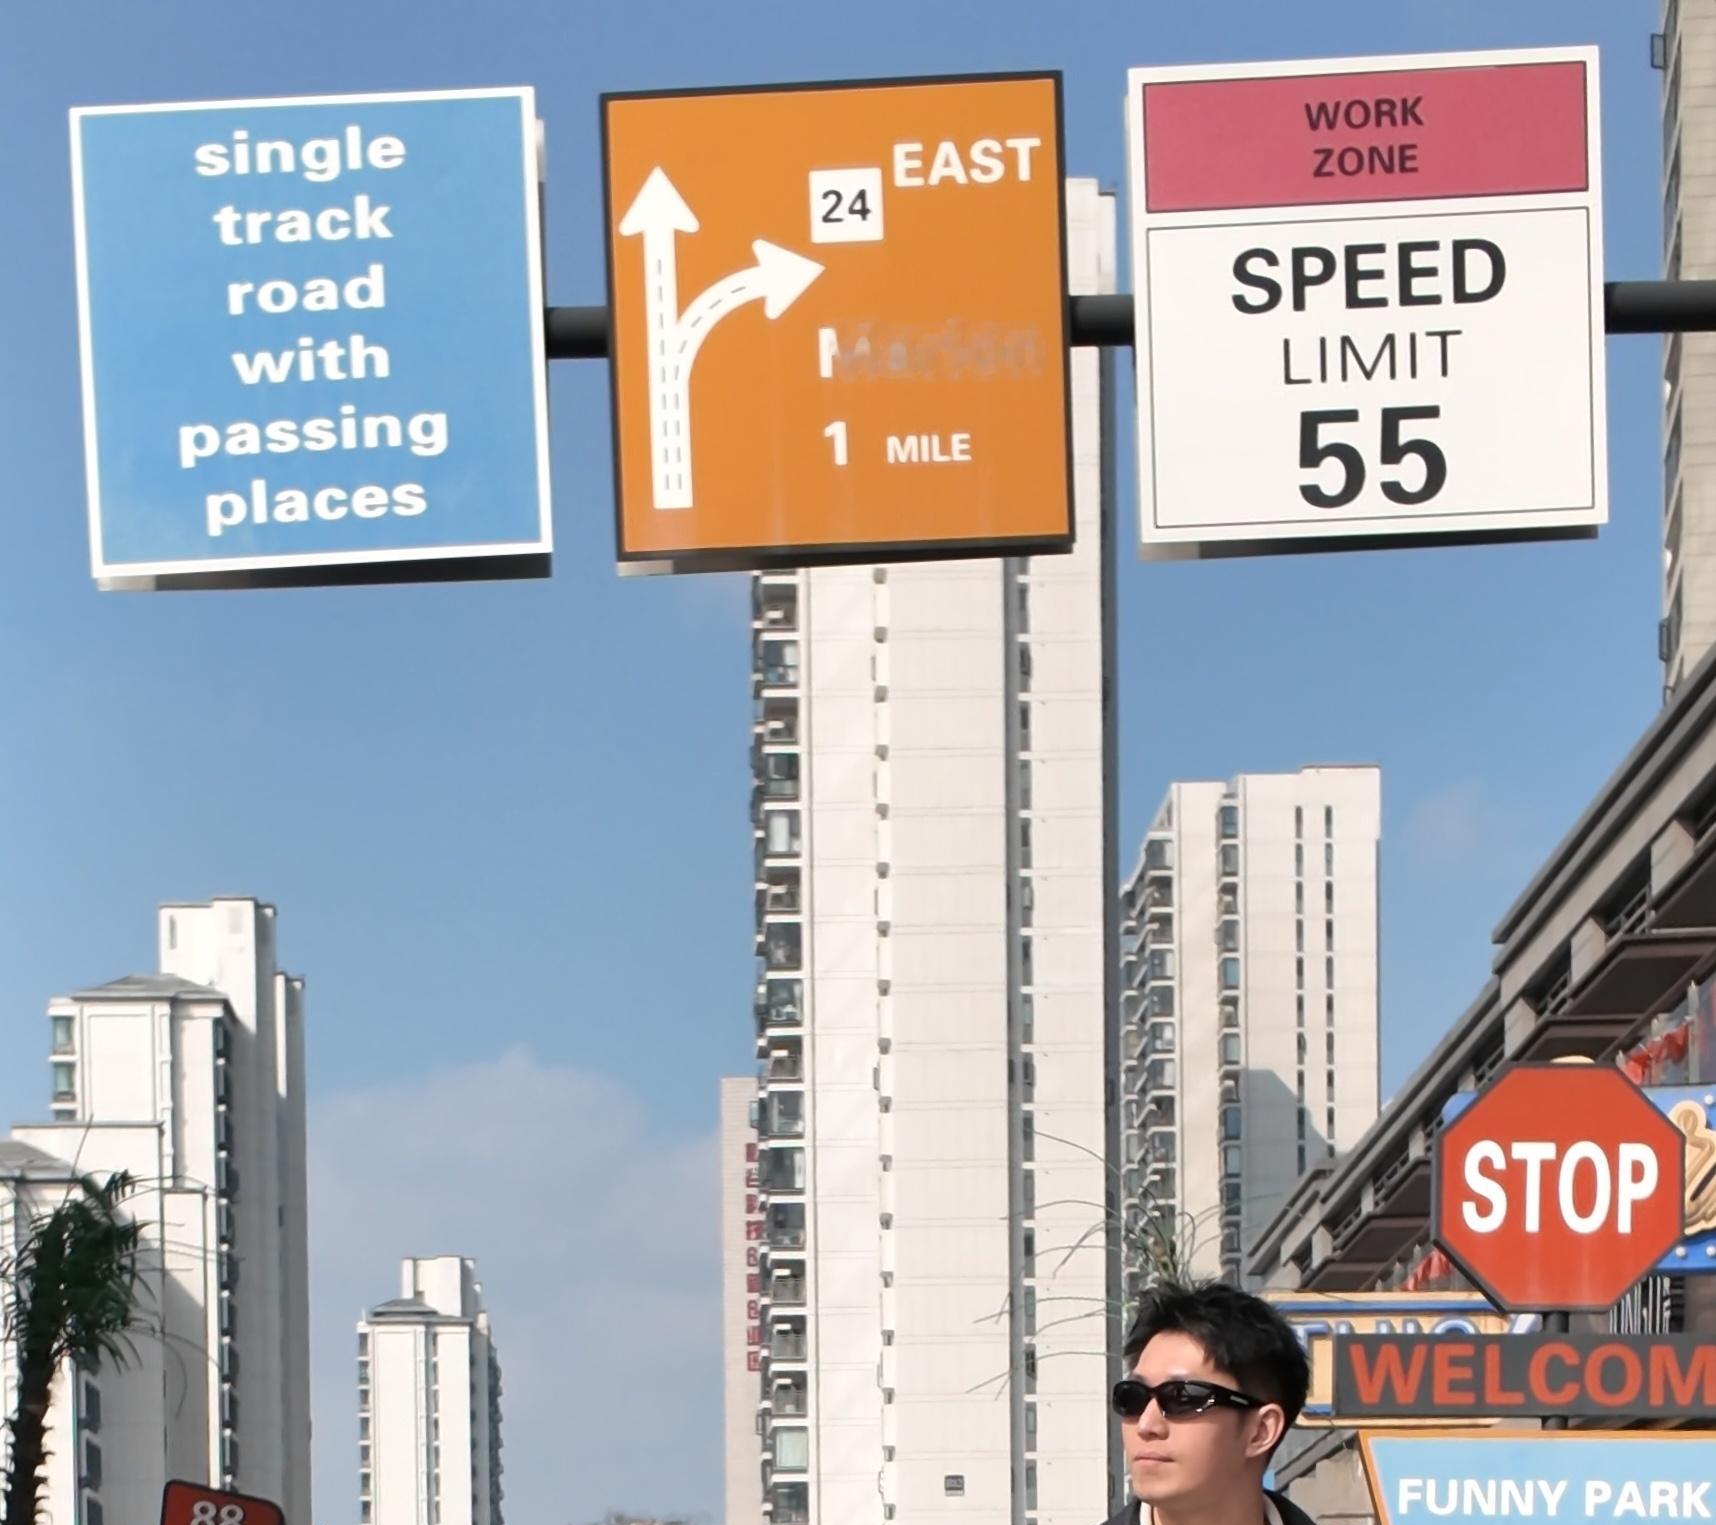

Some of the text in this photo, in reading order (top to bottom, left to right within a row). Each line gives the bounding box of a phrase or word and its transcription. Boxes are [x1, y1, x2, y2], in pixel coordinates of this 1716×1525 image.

[1304, 96, 1424, 131] WORK
[195, 125, 406, 182] single
[893, 138, 1041, 187] EAST
[1312, 144, 1419, 178] ZONE
[213, 195, 393, 245] track
[821, 188, 872, 223] 24
[228, 264, 385, 314] road
[1231, 238, 1506, 315] SPEED
[232, 335, 390, 385] with
[1283, 330, 1463, 385] LIMIT
[179, 405, 448, 468] passing
[823, 421, 972, 466] 1 MILE
[1298, 404, 1448, 508] 55
[206, 479, 427, 537] places
[1461, 1139, 1659, 1235] STOP
[1398, 1478, 1712, 1518] FUNNY PARK
